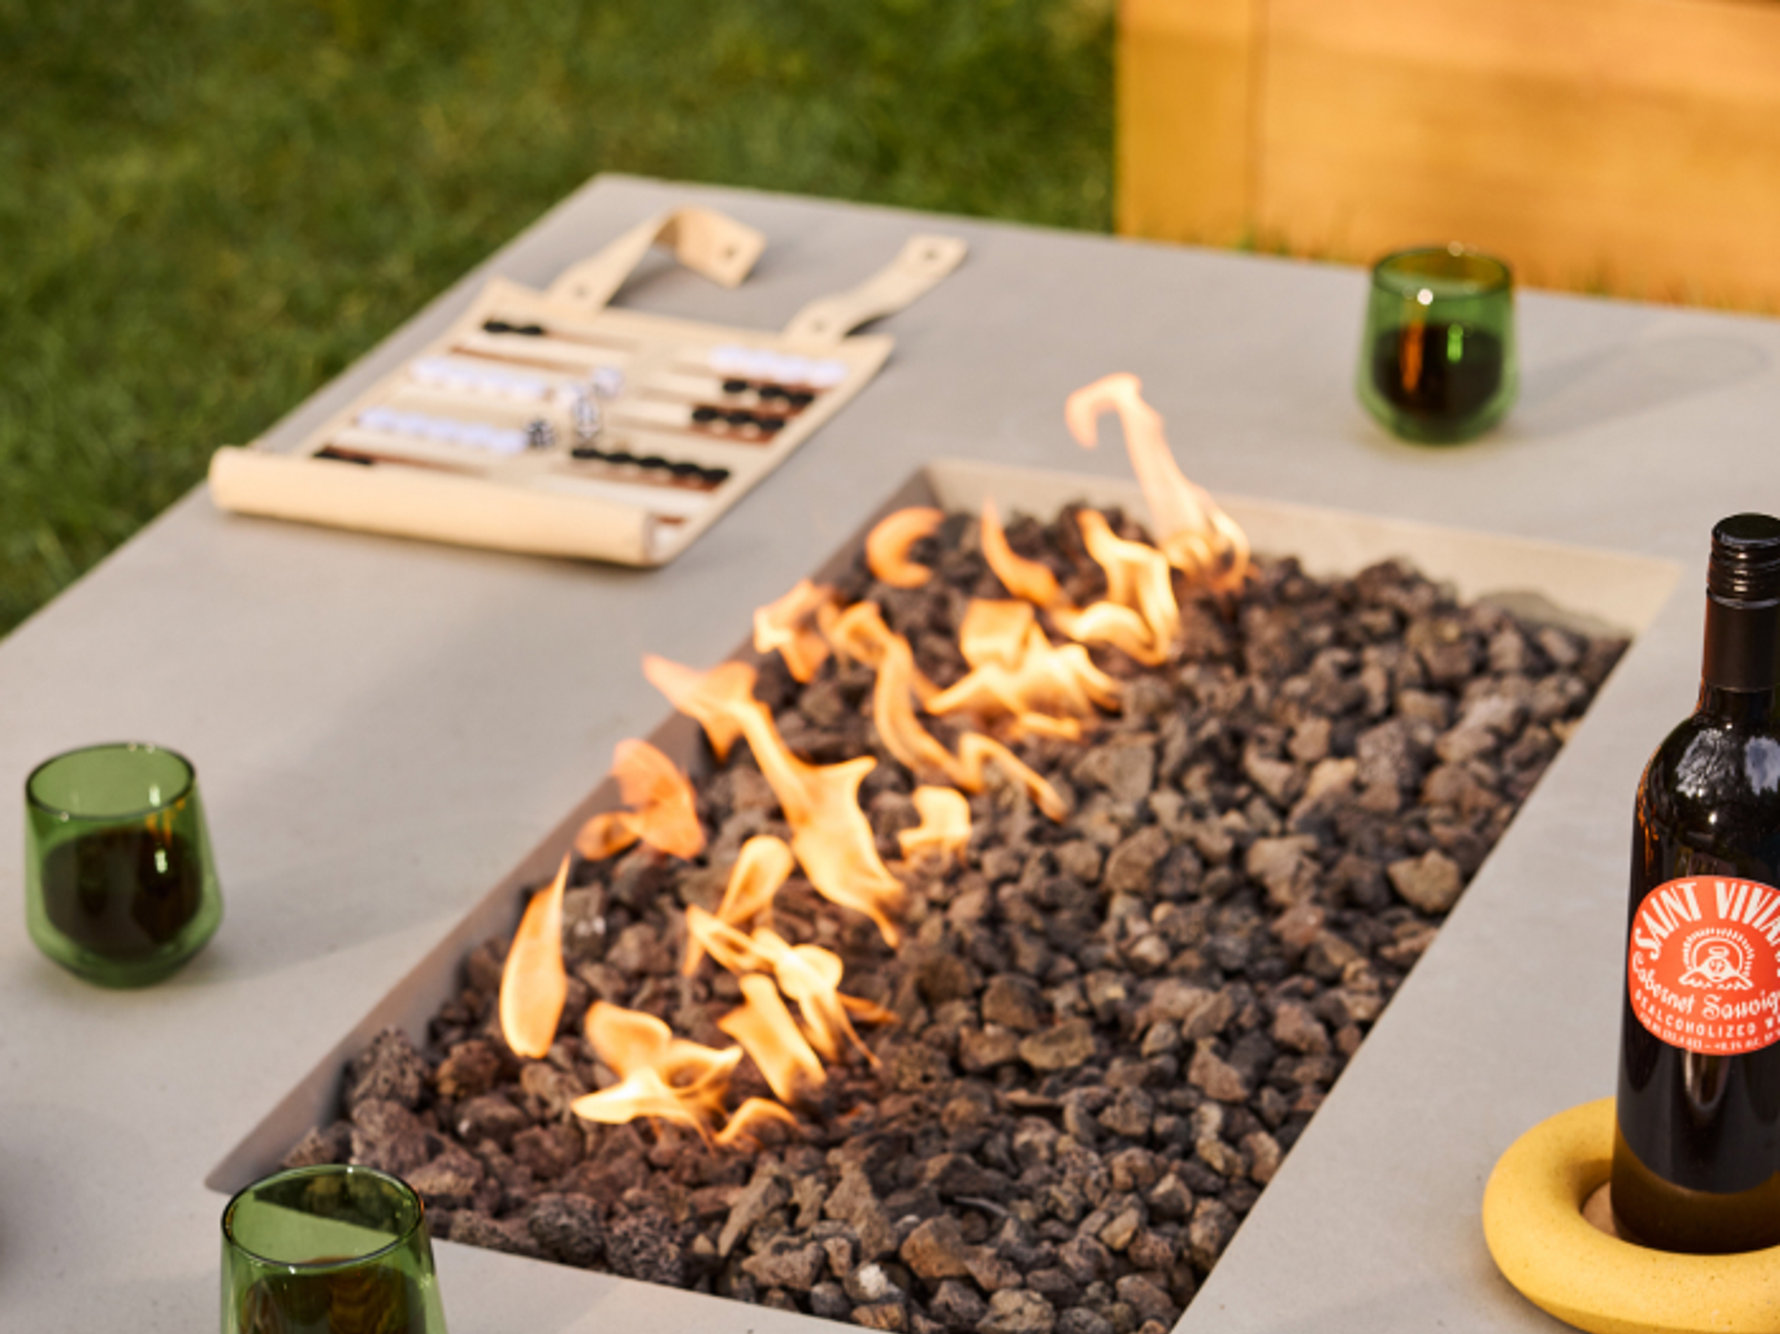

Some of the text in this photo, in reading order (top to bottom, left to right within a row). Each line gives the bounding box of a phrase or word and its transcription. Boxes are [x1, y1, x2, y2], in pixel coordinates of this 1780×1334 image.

[1634, 882, 1702, 960] SAINT
[1633, 951, 1780, 1020] Cabernet Sauvig
[1635, 989, 1756, 1038] DEALCOHOLIZED
